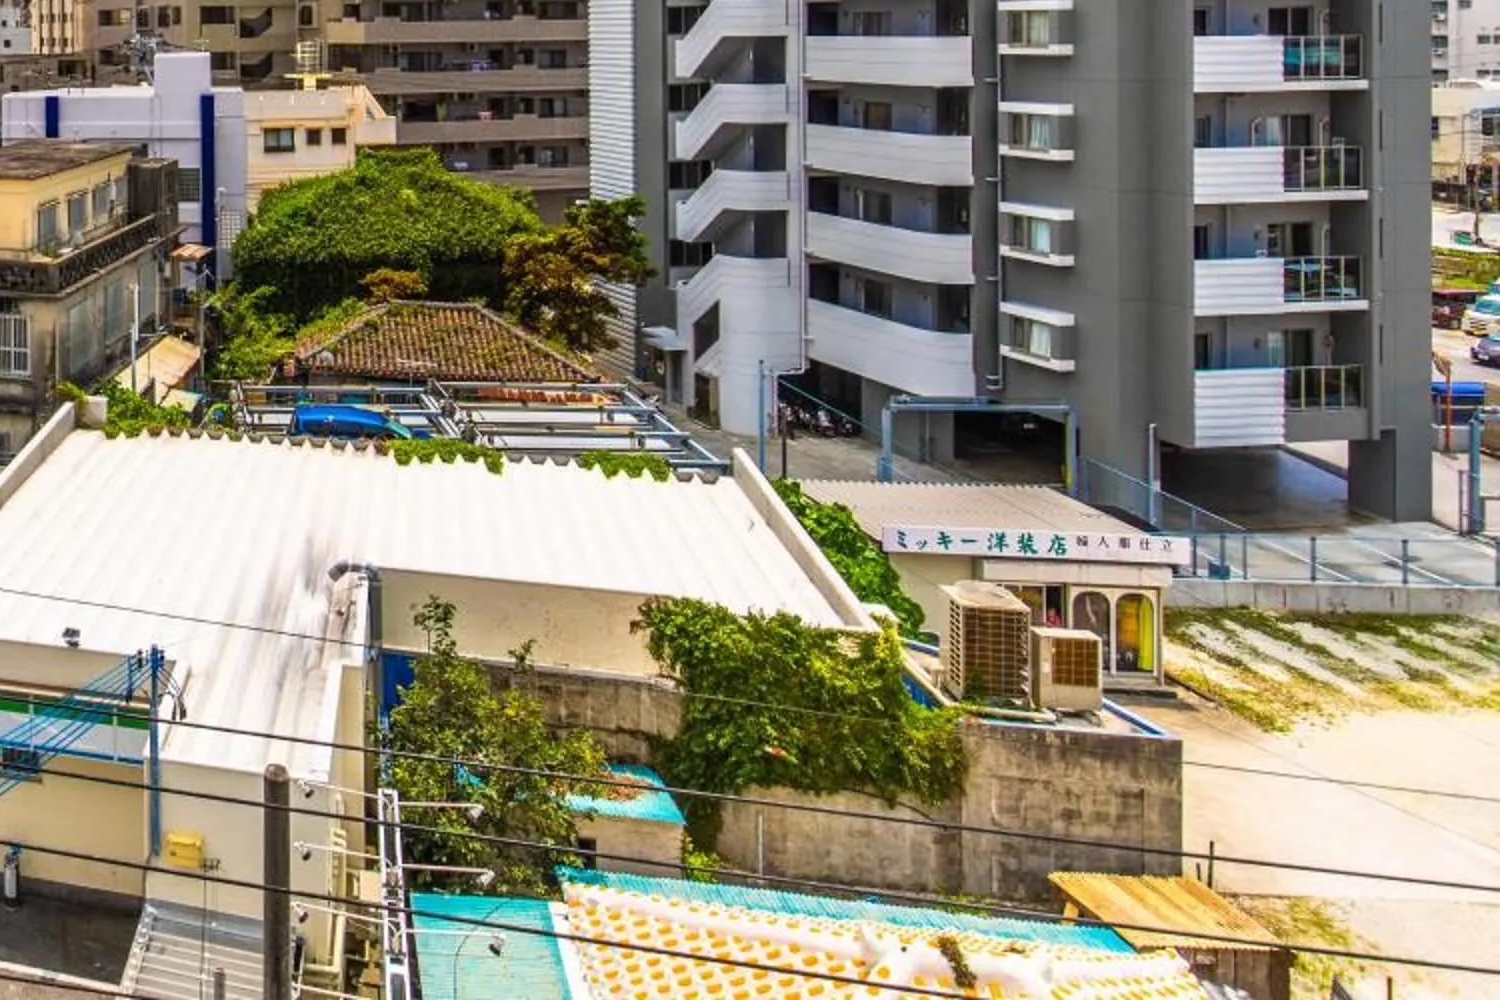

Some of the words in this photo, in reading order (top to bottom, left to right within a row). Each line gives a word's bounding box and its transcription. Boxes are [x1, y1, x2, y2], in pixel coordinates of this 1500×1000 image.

[897, 529, 1068, 557] ミッキー洋装店
